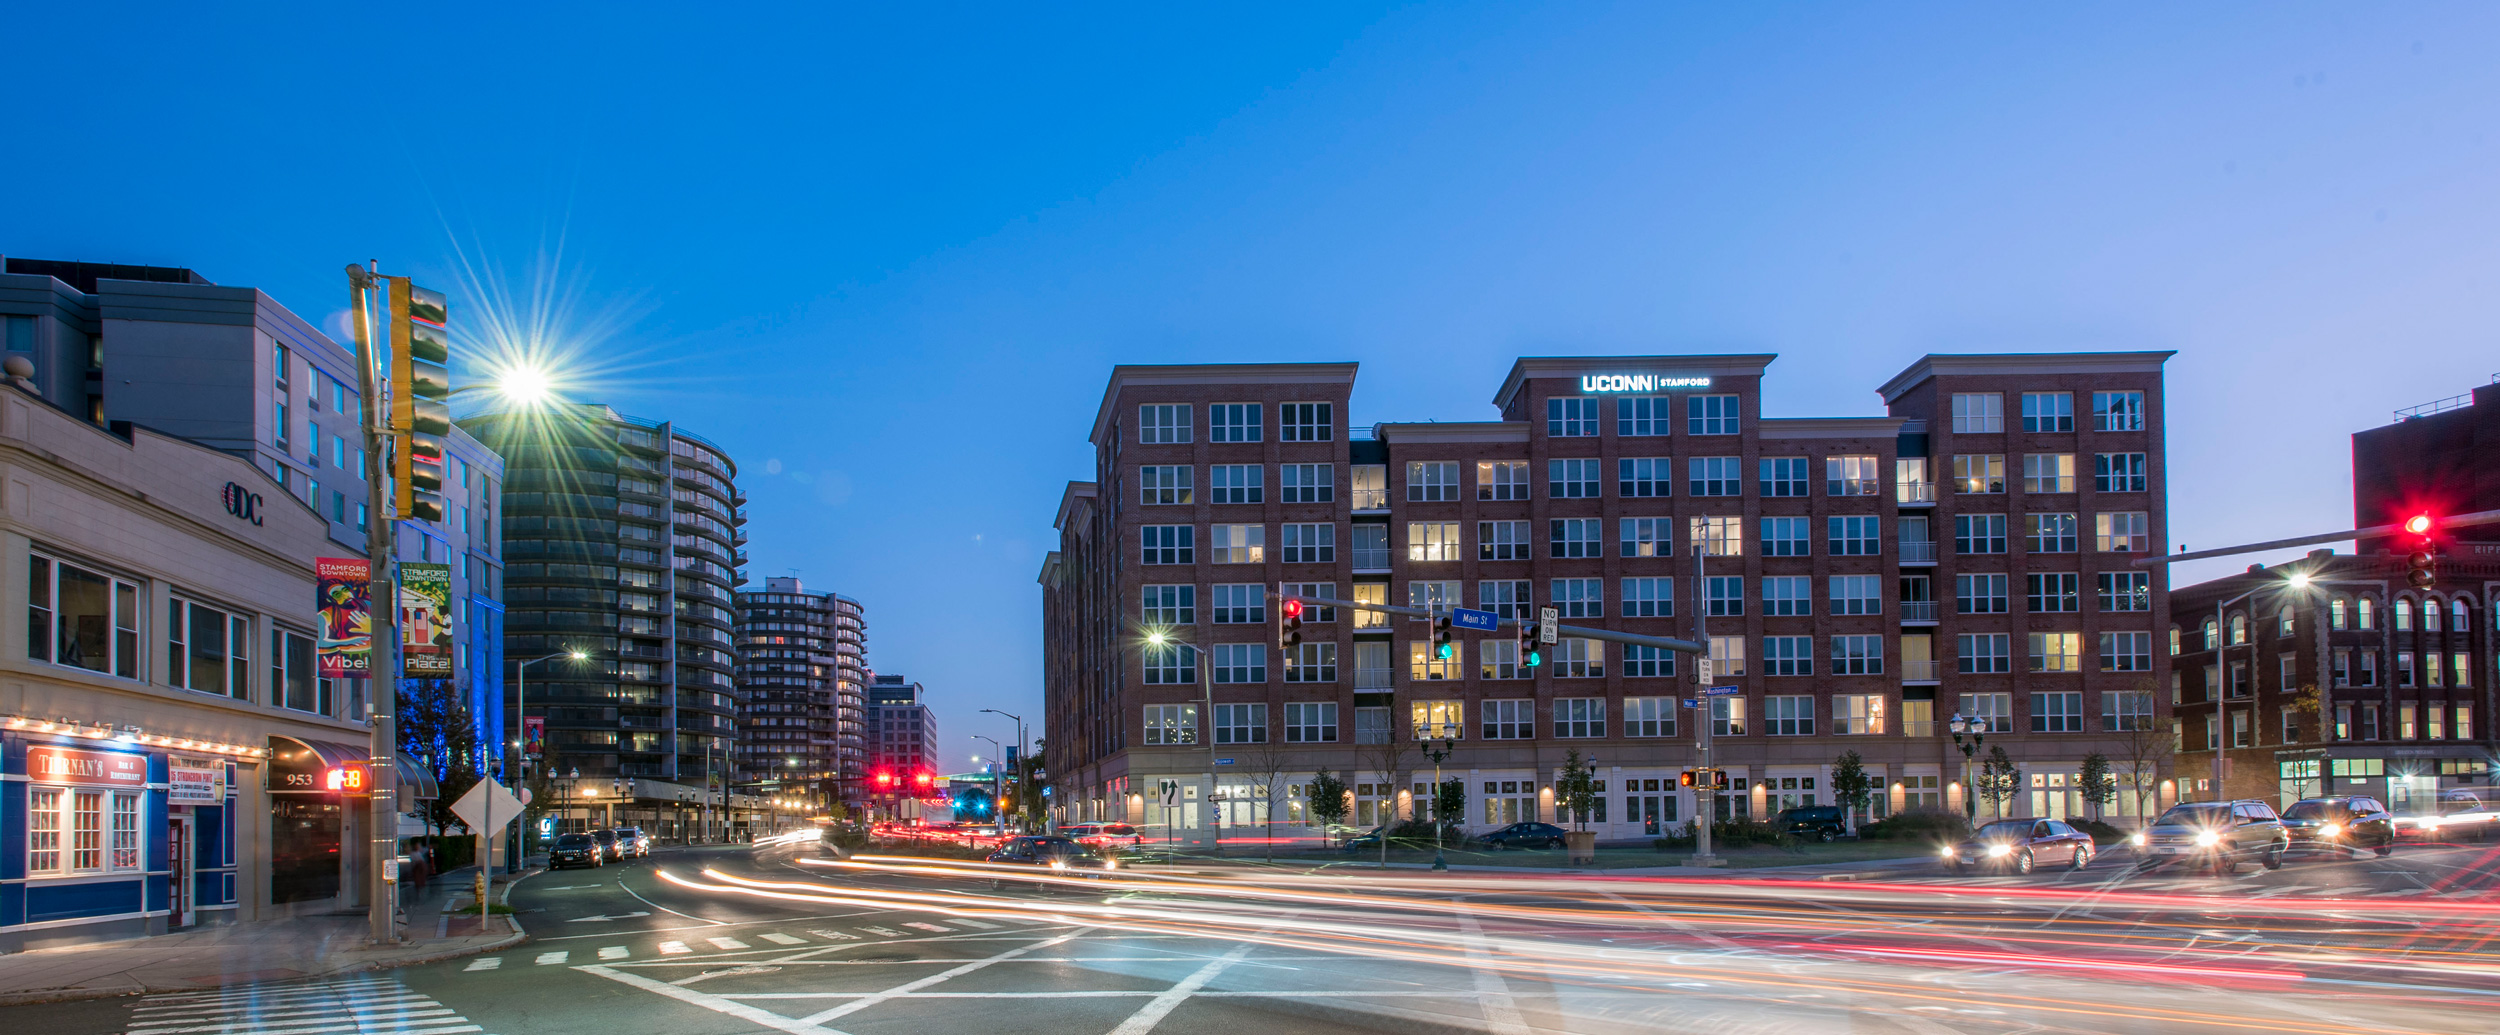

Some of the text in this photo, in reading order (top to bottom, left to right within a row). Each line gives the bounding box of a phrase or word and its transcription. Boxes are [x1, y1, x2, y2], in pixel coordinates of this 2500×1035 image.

[1582, 375, 1710, 391] UCONN STAMFORD
[320, 563, 367, 573] STAMFORD
[321, 569, 366, 577] DOWNTOWN
[402, 568, 448, 577] STAMFORD
[1463, 613, 1488, 625] Main St
[1544, 609, 1555, 619] NO
[1542, 618, 1556, 627] TURN
[1543, 634, 1555, 642] RED
[323, 655, 369, 669] Vibe!
[406, 657, 451, 669] Place!
[287, 773, 313, 786] 953
